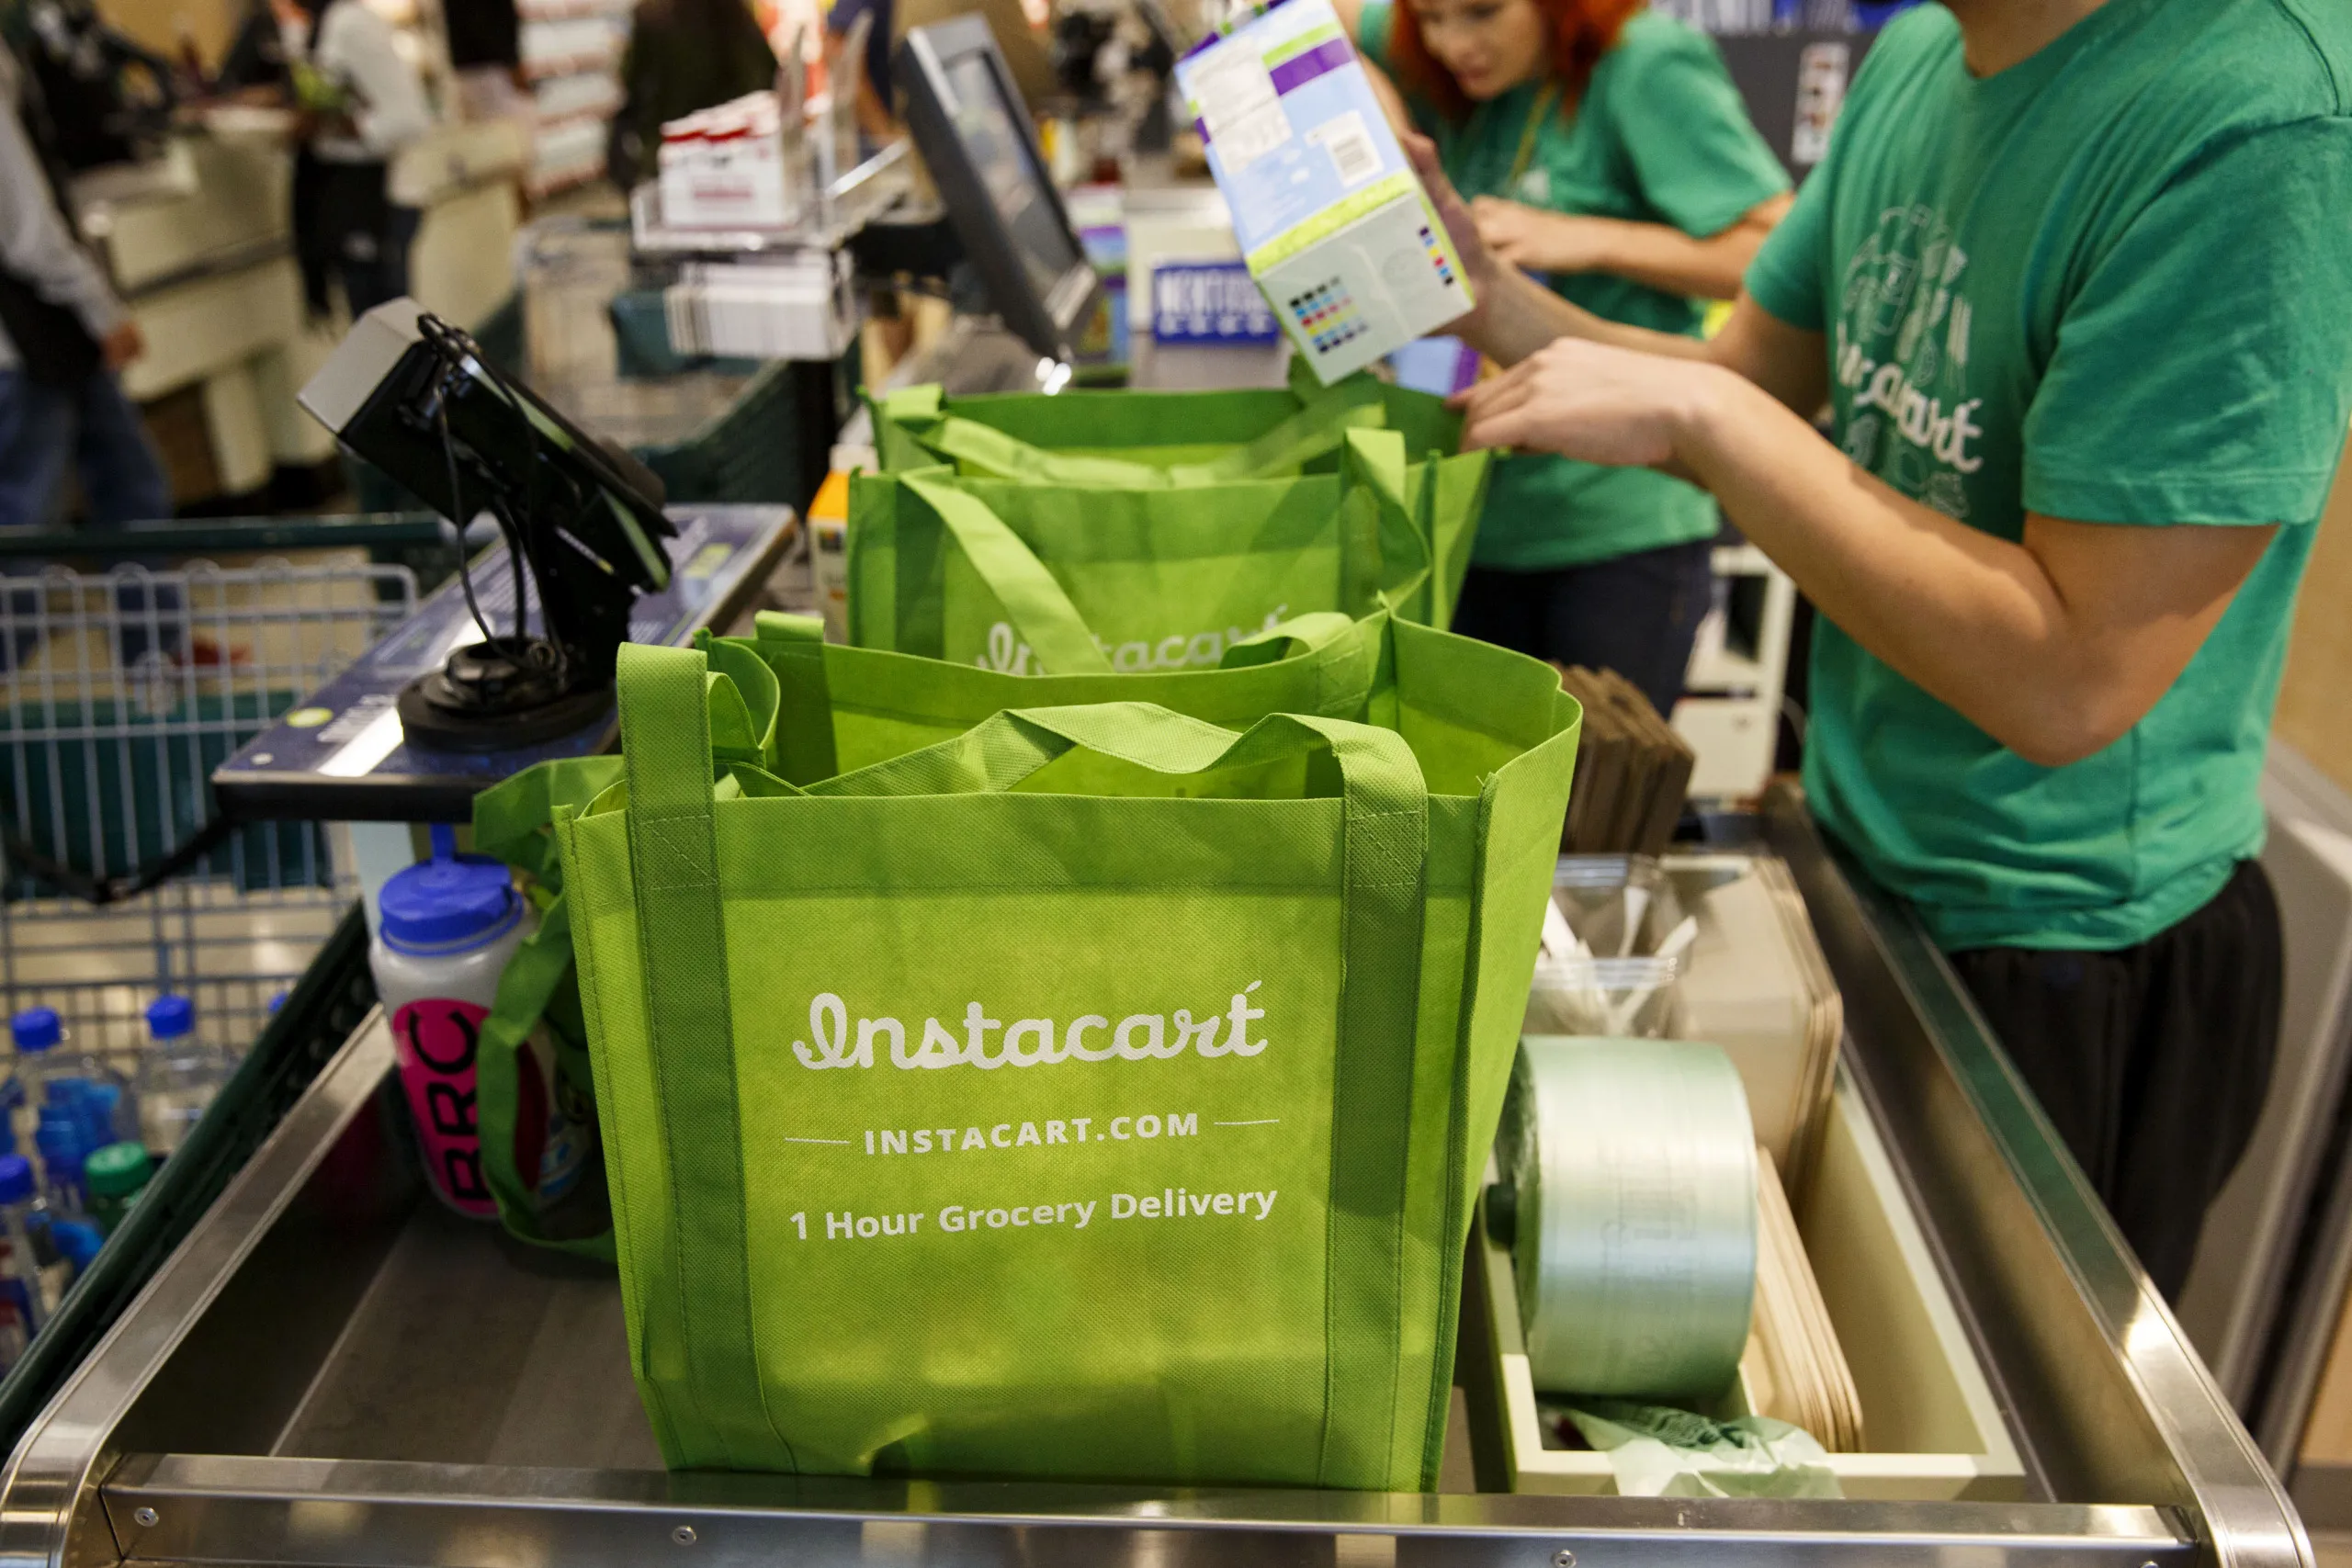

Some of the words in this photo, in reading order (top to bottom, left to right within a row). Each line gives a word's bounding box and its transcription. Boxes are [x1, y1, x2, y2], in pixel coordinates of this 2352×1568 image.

[792, 980, 1269, 1070] Instacart
[865, 1112, 1199, 1156] INSTACART.COM
[789, 1212, 808, 1240] 1
[825, 1208, 925, 1240] Hour
[938, 1196, 1098, 1233] Grocery
[1111, 1188, 1279, 1221] Delivery
